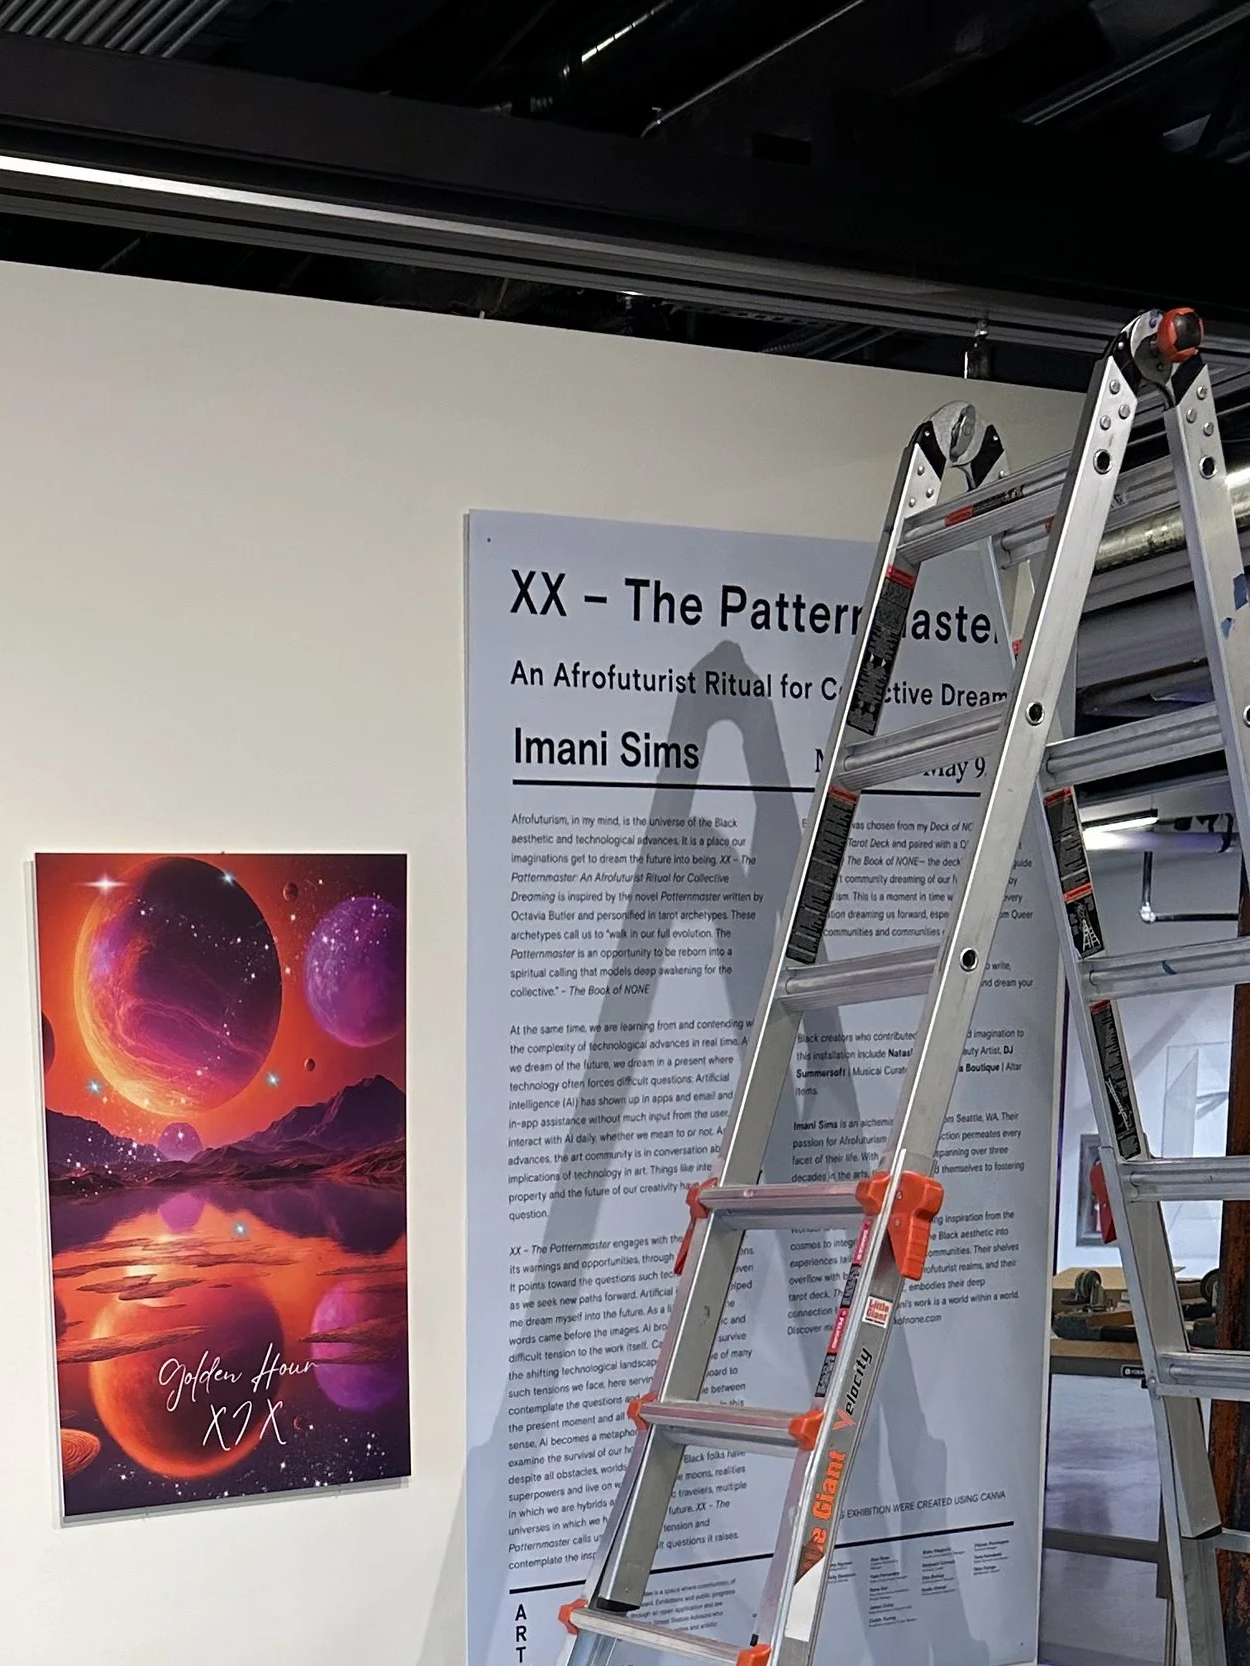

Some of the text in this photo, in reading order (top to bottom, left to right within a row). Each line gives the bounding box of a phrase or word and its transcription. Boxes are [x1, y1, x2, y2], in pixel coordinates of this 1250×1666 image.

[510, 569, 567, 616] XX
[624, 577, 702, 625] The
[510, 660, 543, 686] An
[553, 661, 697, 694] Afrofuturist
[705, 671, 772, 698] Ritual
[780, 673, 812, 700] for
[514, 727, 607, 766] Imani
[620, 731, 700, 769] Sims
[923, 757, 968, 783] ay
[633, 817, 646, 826] the
[649, 817, 685, 827] universe
[699, 817, 713, 828] the
[715, 817, 737, 828] Black
[866, 821, 895, 830] chosen
[897, 821, 915, 831] from
[930, 822, 949, 831] Deck
[512, 834, 554, 844] aesthetic
[556, 834, 573, 844] and
[576, 834, 635, 847] technological
[707, 836, 731, 848] place
[732, 838, 746, 846] our
[847, 838, 868, 848] Tarot
[870, 838, 889, 848] Deck
[892, 839, 906, 848] and
[908, 840, 934, 850] paired
[935, 840, 951, 849] with
[511, 853, 568, 866] imaginations
[571, 854, 585, 866] get
[599, 854, 627, 863] dream
[630, 854, 644, 864] the
[646, 853, 671, 864] future
[674, 854, 690, 864] into
[742, 855, 756, 865] The
[848, 855, 861, 865] The
[863, 856, 883, 866] Book
[928, 857, 941, 867] the
[594, 872, 643, 883] Afrofuturist
[646, 873, 671, 883] Ritual
[673, 872, 685, 883] for
[687, 873, 729, 883] Collective
[511, 891, 555, 904] Dreaming
[568, 891, 603, 903] inspired
[619, 892, 633, 901] the
[635, 892, 658, 901] novel
[661, 891, 721, 904] Patternmaster
[723, 892, 751, 901] written
[511, 911, 546, 921] Octavia
[549, 910, 575, 920] Butler
[578, 911, 594, 920] and
[597, 909, 646, 922] personified
[658, 911, 678, 920] tarot
[731, 909, 756, 920] These
[570, 986, 586, 996] The
[588, 985, 610, 995] Book
[624, 984, 650, 994] NONE
[523, 1025, 538, 1035] the
[540, 1026, 564, 1034] same
[604, 1024, 618, 1032] are
[620, 1022, 655, 1033] learning
[657, 1020, 676, 1030] from
[679, 1020, 695, 1030] and
[697, 1019, 743, 1031] contending
[797, 1049, 886, 1060] this installation include
[524, 1062, 552, 1072] dream
[566, 1061, 581, 1070] the
[627, 1058, 654, 1068] dream
[674, 1056, 706, 1068] present
[708, 1055, 734, 1064] where
[796, 1062, 1022, 1078] Summersoft Musical Boutique Altar
[510, 1081, 559, 1092] technology
[561, 1079, 585, 1089] often
[588, 1077, 615, 1088] forces
[616, 1076, 648, 1086] difficult
[696, 1072, 729, 1083] Artificial
[794, 1120, 838, 1130] Imani Sims
[938, 1228, 1009, 1240] Black aesthetic into
[510, 1265, 520, 1274] its
[523, 1263, 561, 1274] warnings
[563, 1260, 579, 1270] and
[642, 1253, 673, 1265] through
[868, 1298, 889, 1312] Little
[866, 1308, 887, 1321] Giant
[159, 1342, 319, 1412] Golden Hour
[832, 1347, 872, 1430] Velocity
[813, 1451, 846, 1520] Giant
[847, 1490, 1006, 1519] EXHIBITION WERE CREATED USING CANVA
